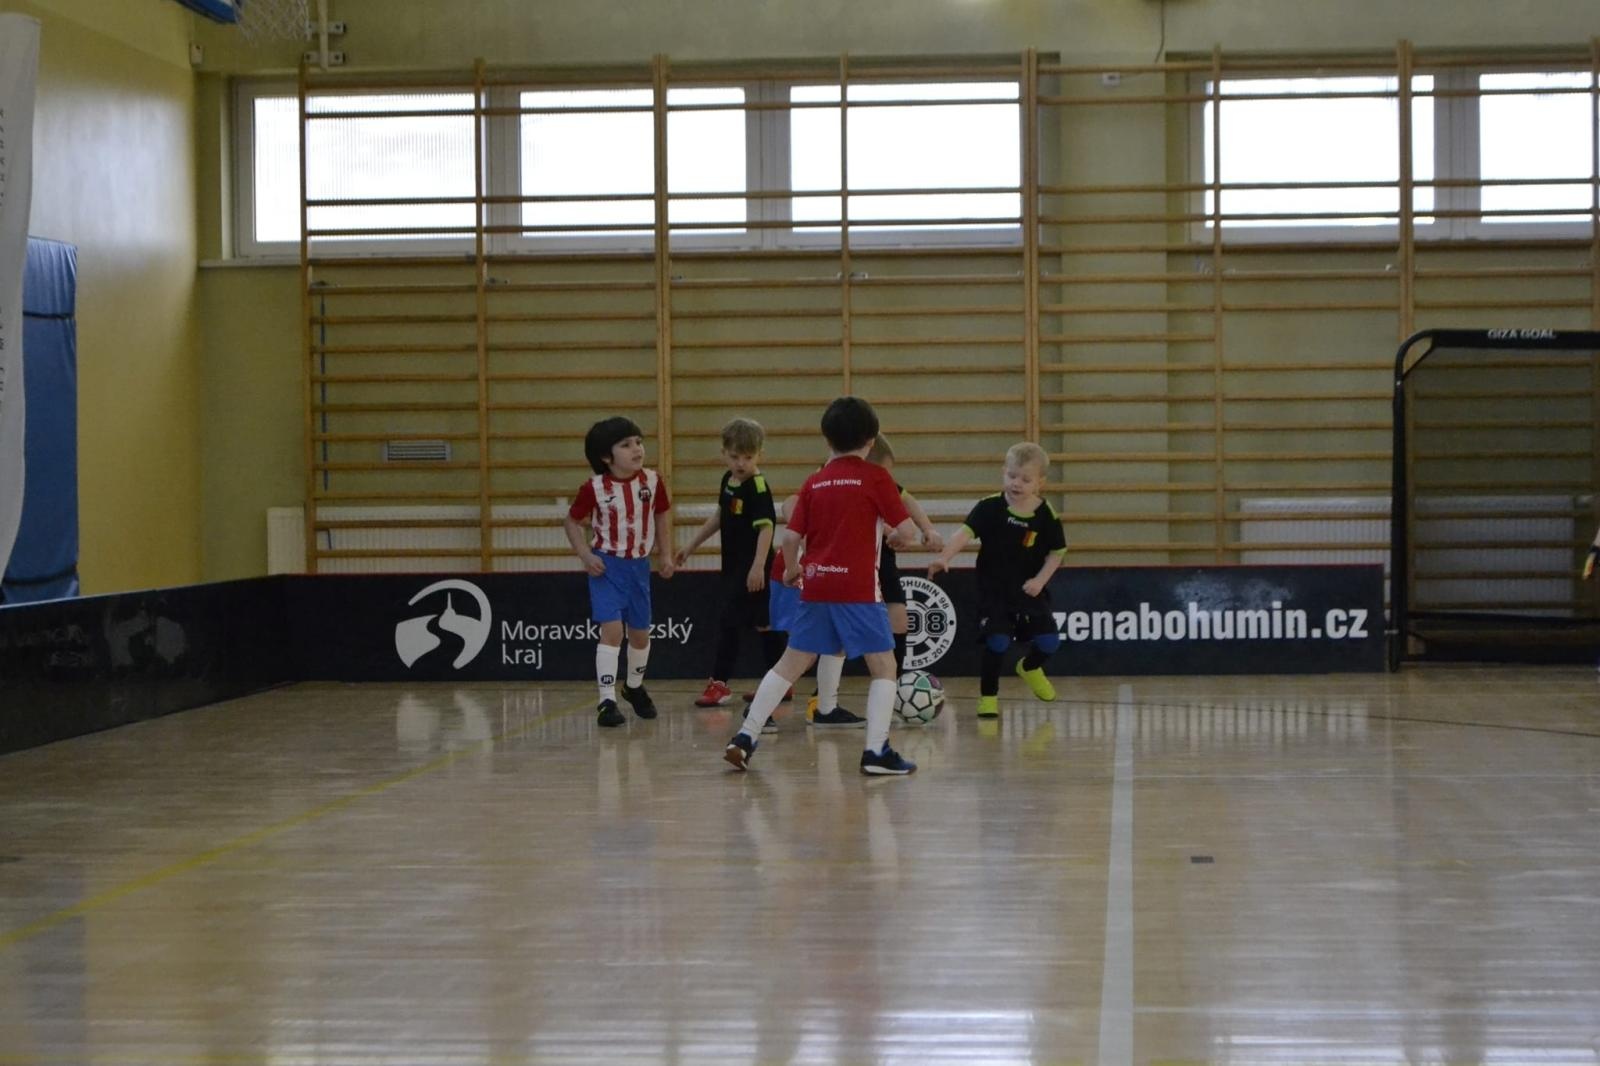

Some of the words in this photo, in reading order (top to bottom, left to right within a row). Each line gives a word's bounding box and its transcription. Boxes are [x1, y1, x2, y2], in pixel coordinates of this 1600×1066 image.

[1520, 328, 1557, 340] GOAL
[501, 617, 693, 644] Moravskzský
[502, 643, 543, 669] kraj
